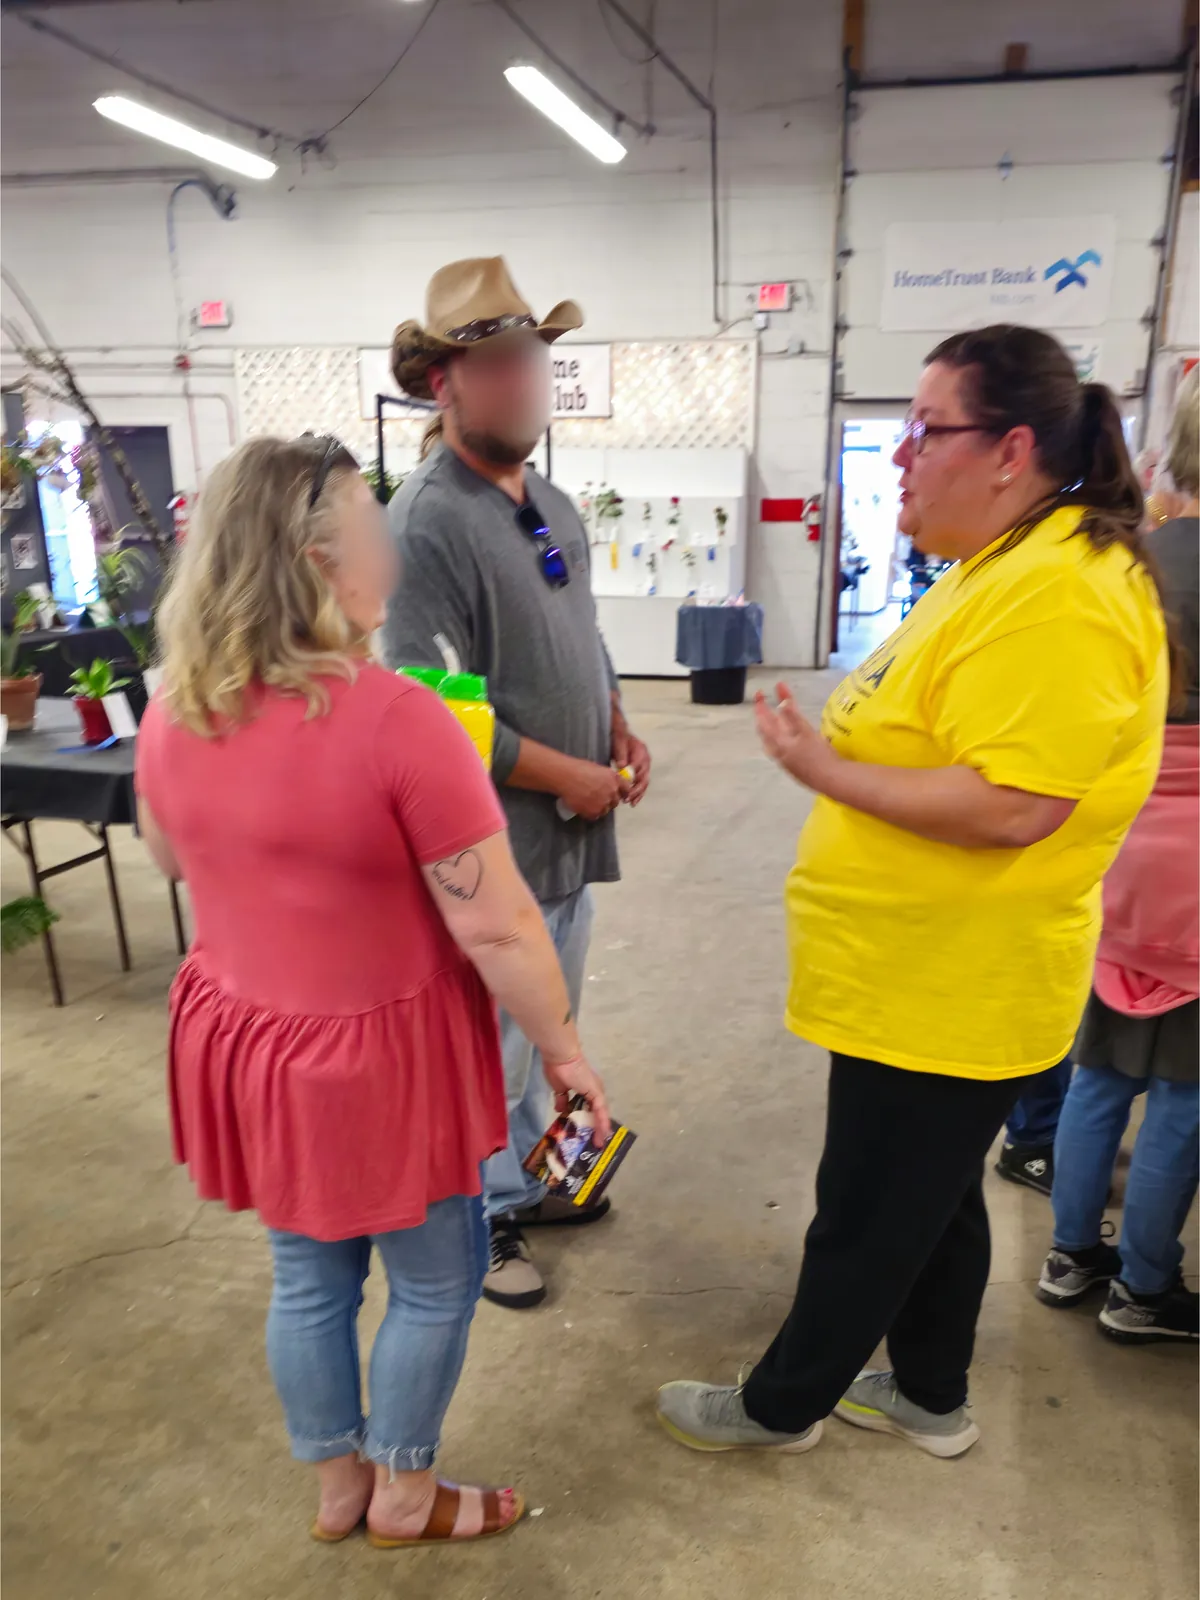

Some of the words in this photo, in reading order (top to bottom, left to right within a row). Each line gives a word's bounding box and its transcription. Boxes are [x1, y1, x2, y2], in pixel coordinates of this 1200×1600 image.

[893, 267, 987, 289] HomeTrust
[991, 266, 1037, 285] Bank
[555, 383, 588, 411] lub
